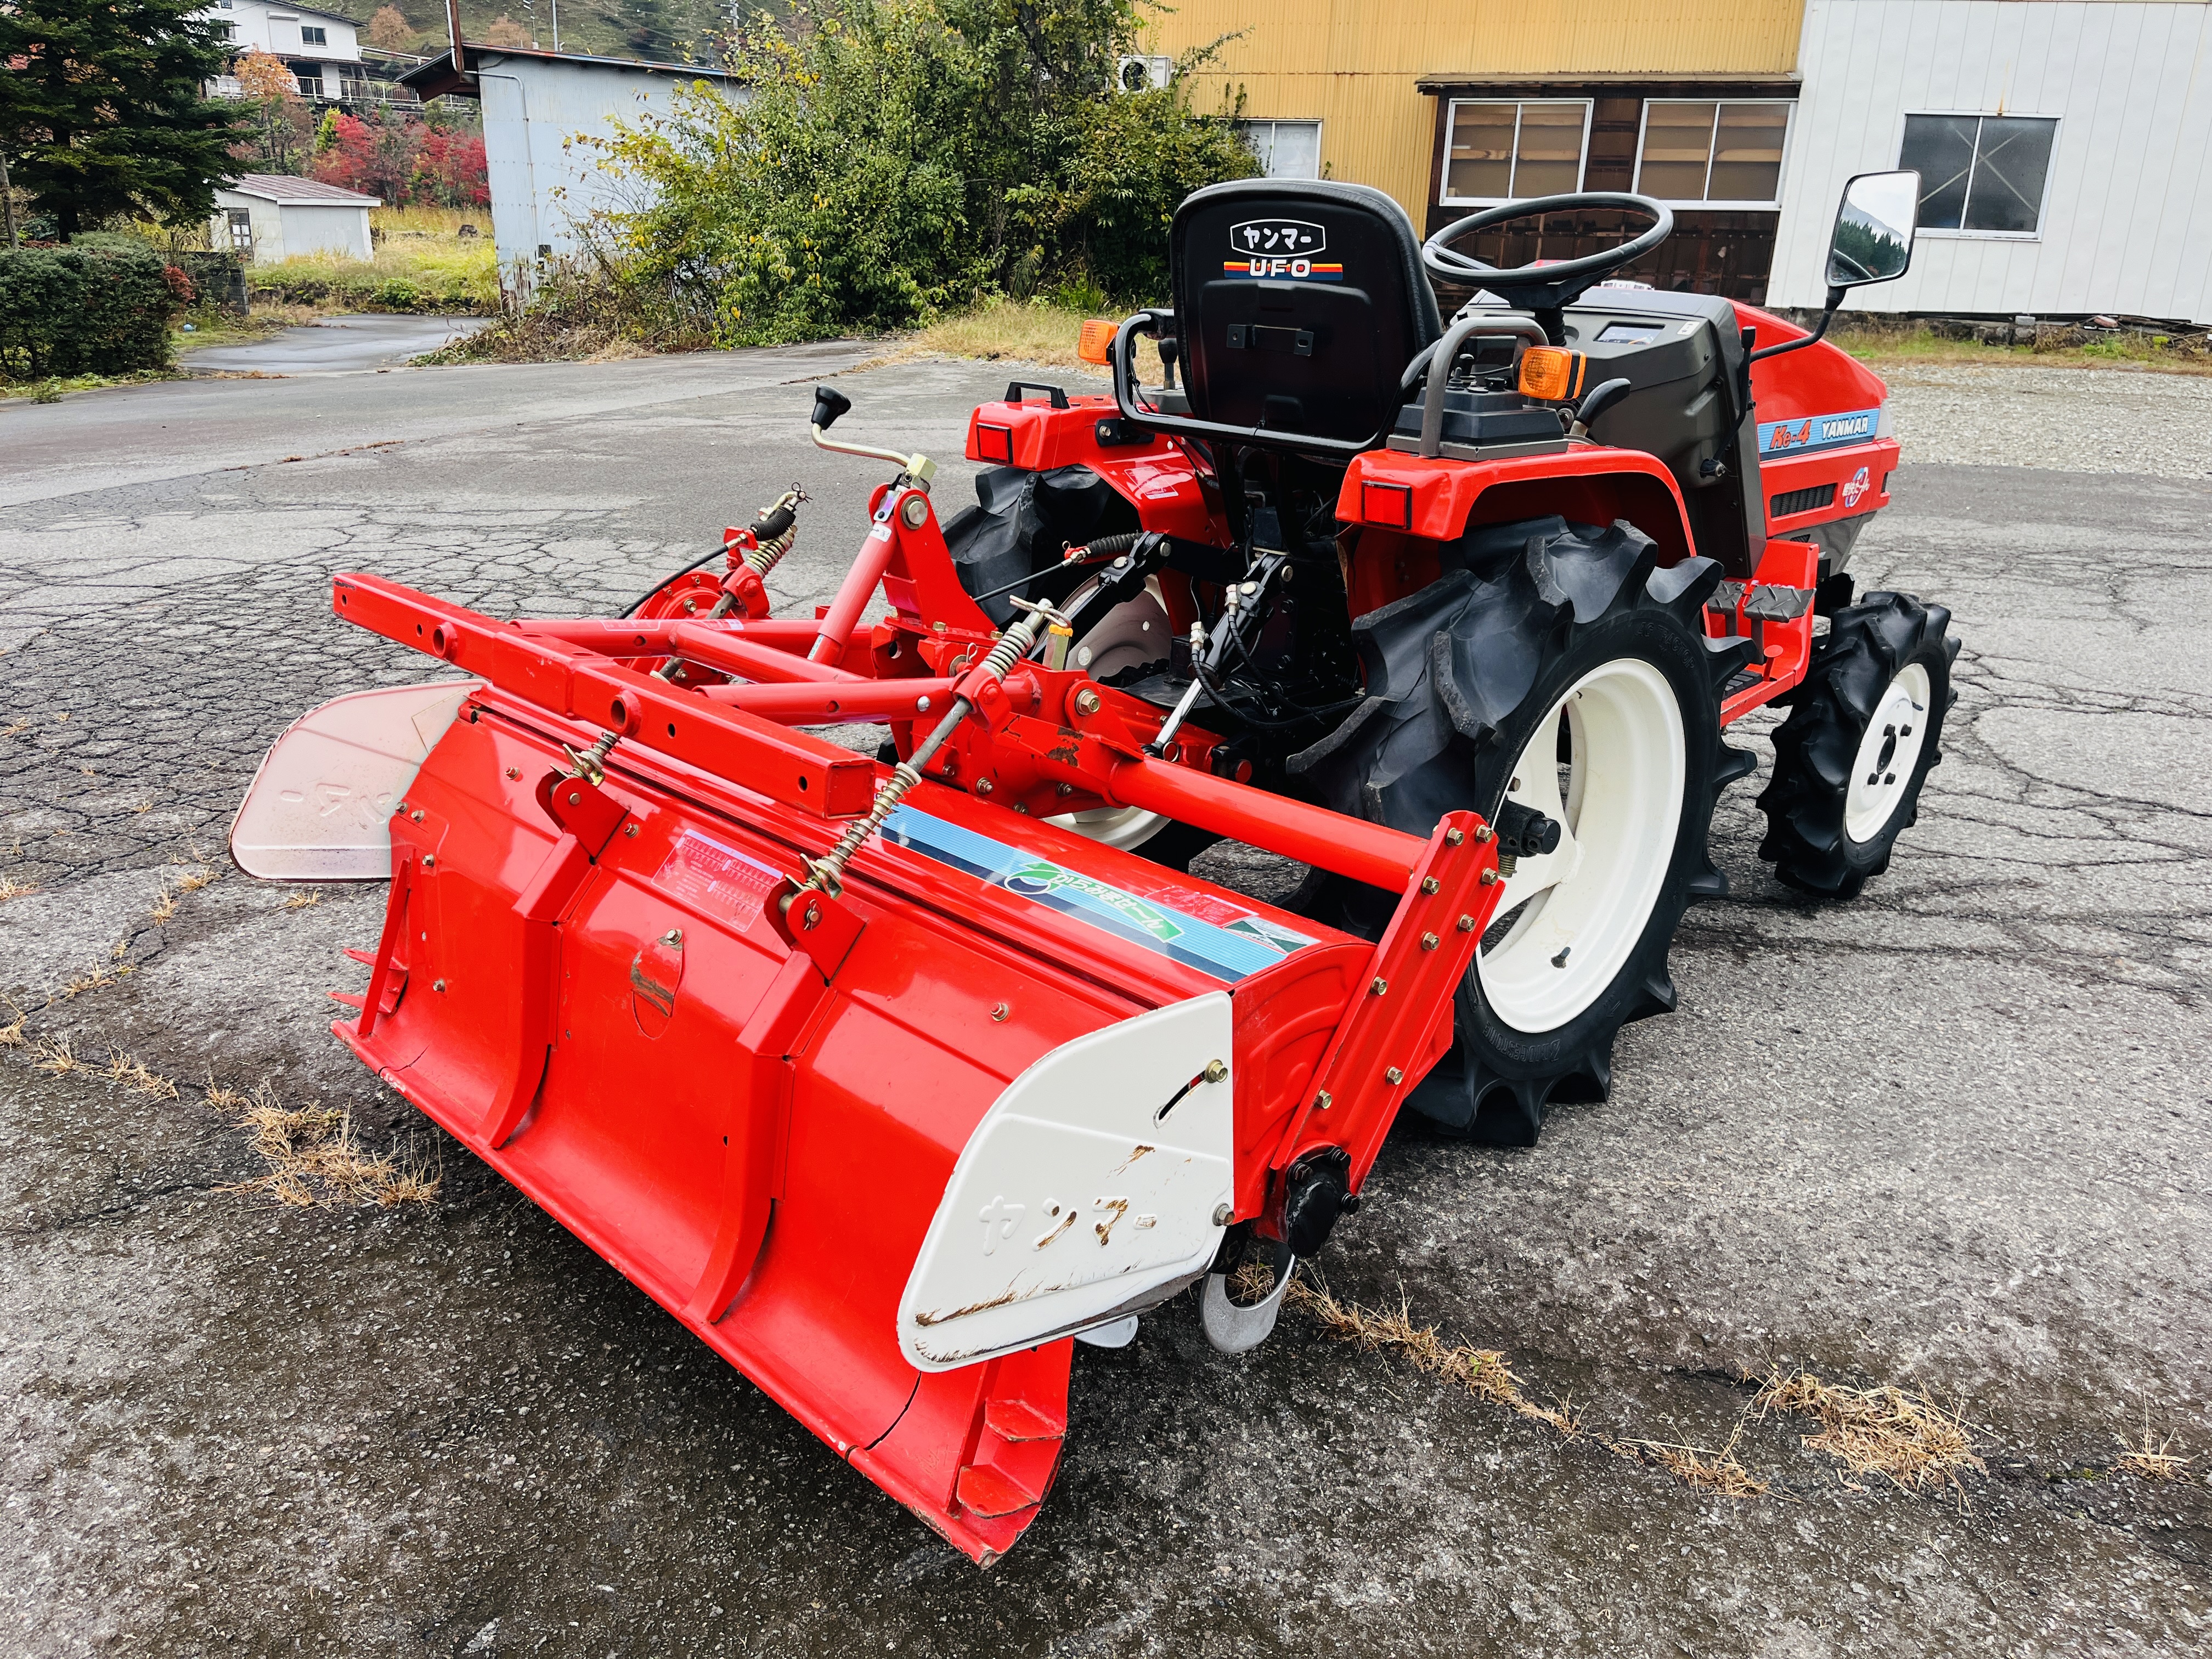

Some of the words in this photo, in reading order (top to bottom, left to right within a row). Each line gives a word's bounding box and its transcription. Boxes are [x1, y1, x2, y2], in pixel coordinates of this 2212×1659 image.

[1243, 226, 1312, 250] ヤンマー
[1249, 258, 1311, 277] UFO
[1769, 420, 1812, 450] Ke-4
[1822, 415, 1869, 440] YANMAR
[978, 1195, 1158, 1256] ヤンマー
